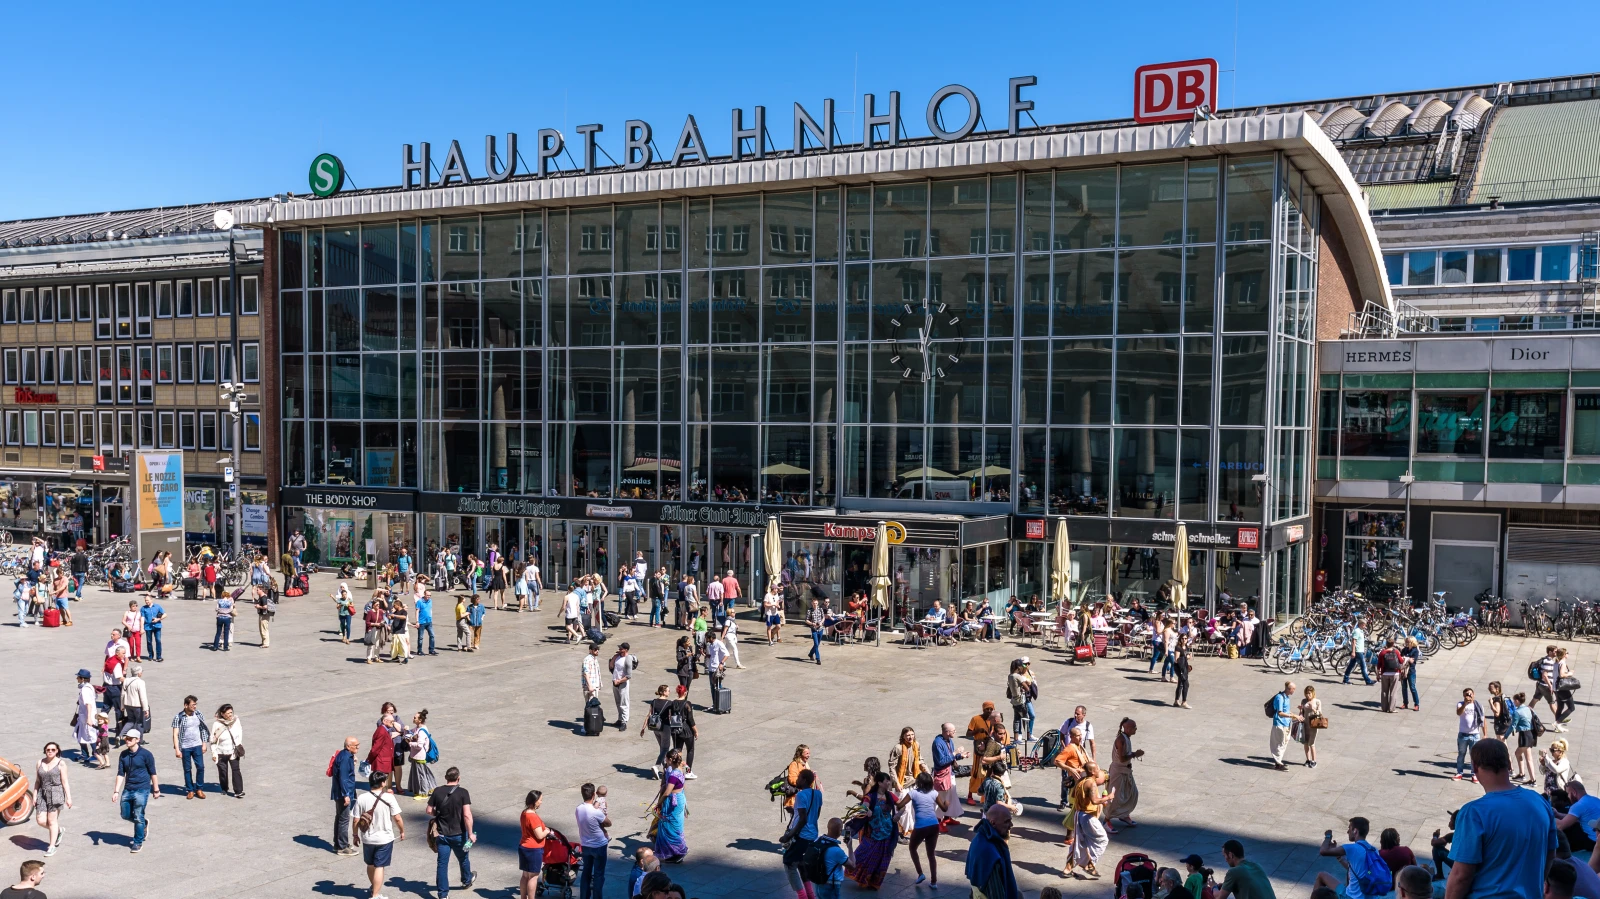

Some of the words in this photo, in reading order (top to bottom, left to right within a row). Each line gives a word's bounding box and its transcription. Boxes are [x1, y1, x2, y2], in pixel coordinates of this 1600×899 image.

[1143, 71, 1209, 111] DB
[402, 75, 1036, 190] HAUPTBAHNHOF
[314, 158, 336, 191] S
[1345, 350, 1412, 362] HERMÈS
[1509, 347, 1550, 361] Dior
[1384, 397, 1520, 441] Douglas
[145, 473, 153, 482] LE
[154, 472, 176, 482] NOZZE
[142, 483, 152, 493] DI
[152, 483, 179, 492] FIGARO
[305, 493, 323, 505] THE
[324, 493, 350, 506] BODY
[351, 494, 377, 507] SHOP
[823, 522, 876, 541] Kamps
[1151, 531, 1177, 542] schne
[1239, 530, 1257, 543] EXPRESS
